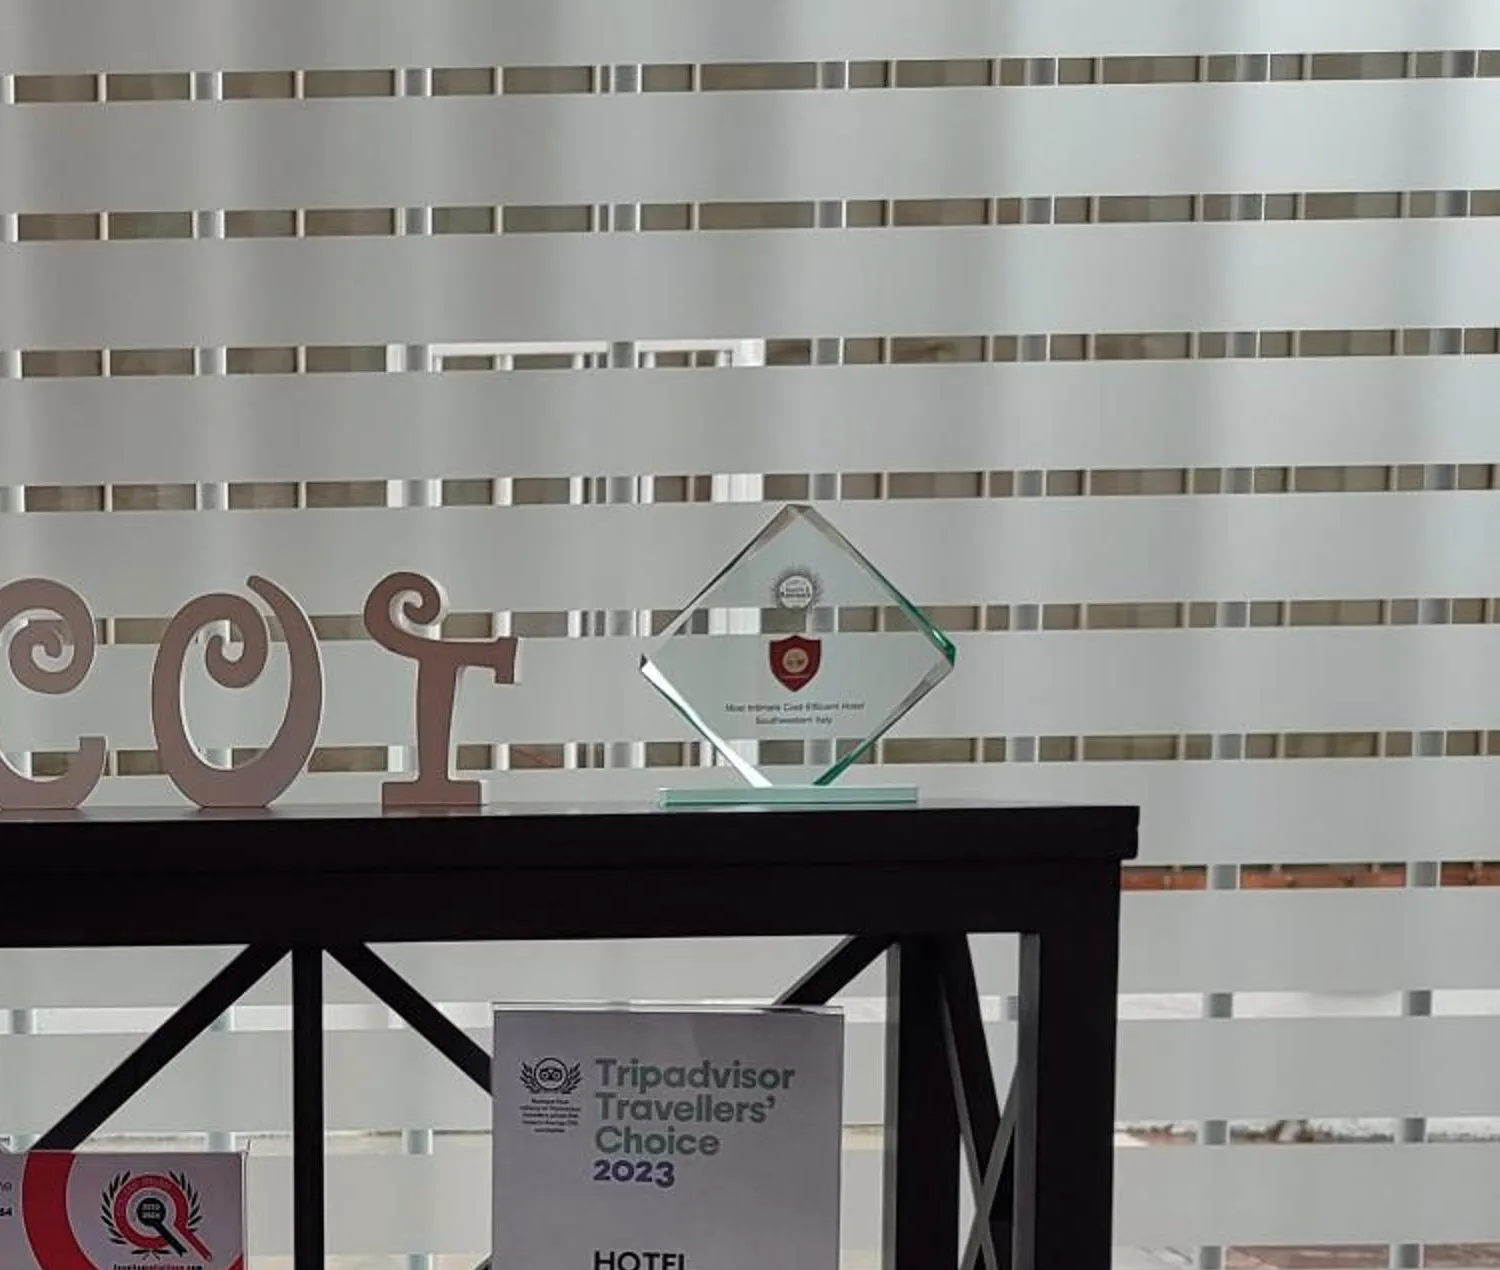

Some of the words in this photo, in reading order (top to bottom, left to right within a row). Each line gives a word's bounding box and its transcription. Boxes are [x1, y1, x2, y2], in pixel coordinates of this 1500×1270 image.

[595, 1058, 795, 1093] Tripadvisor
[595, 1126, 720, 1156] Choice
[593, 1160, 675, 1188] 2023
